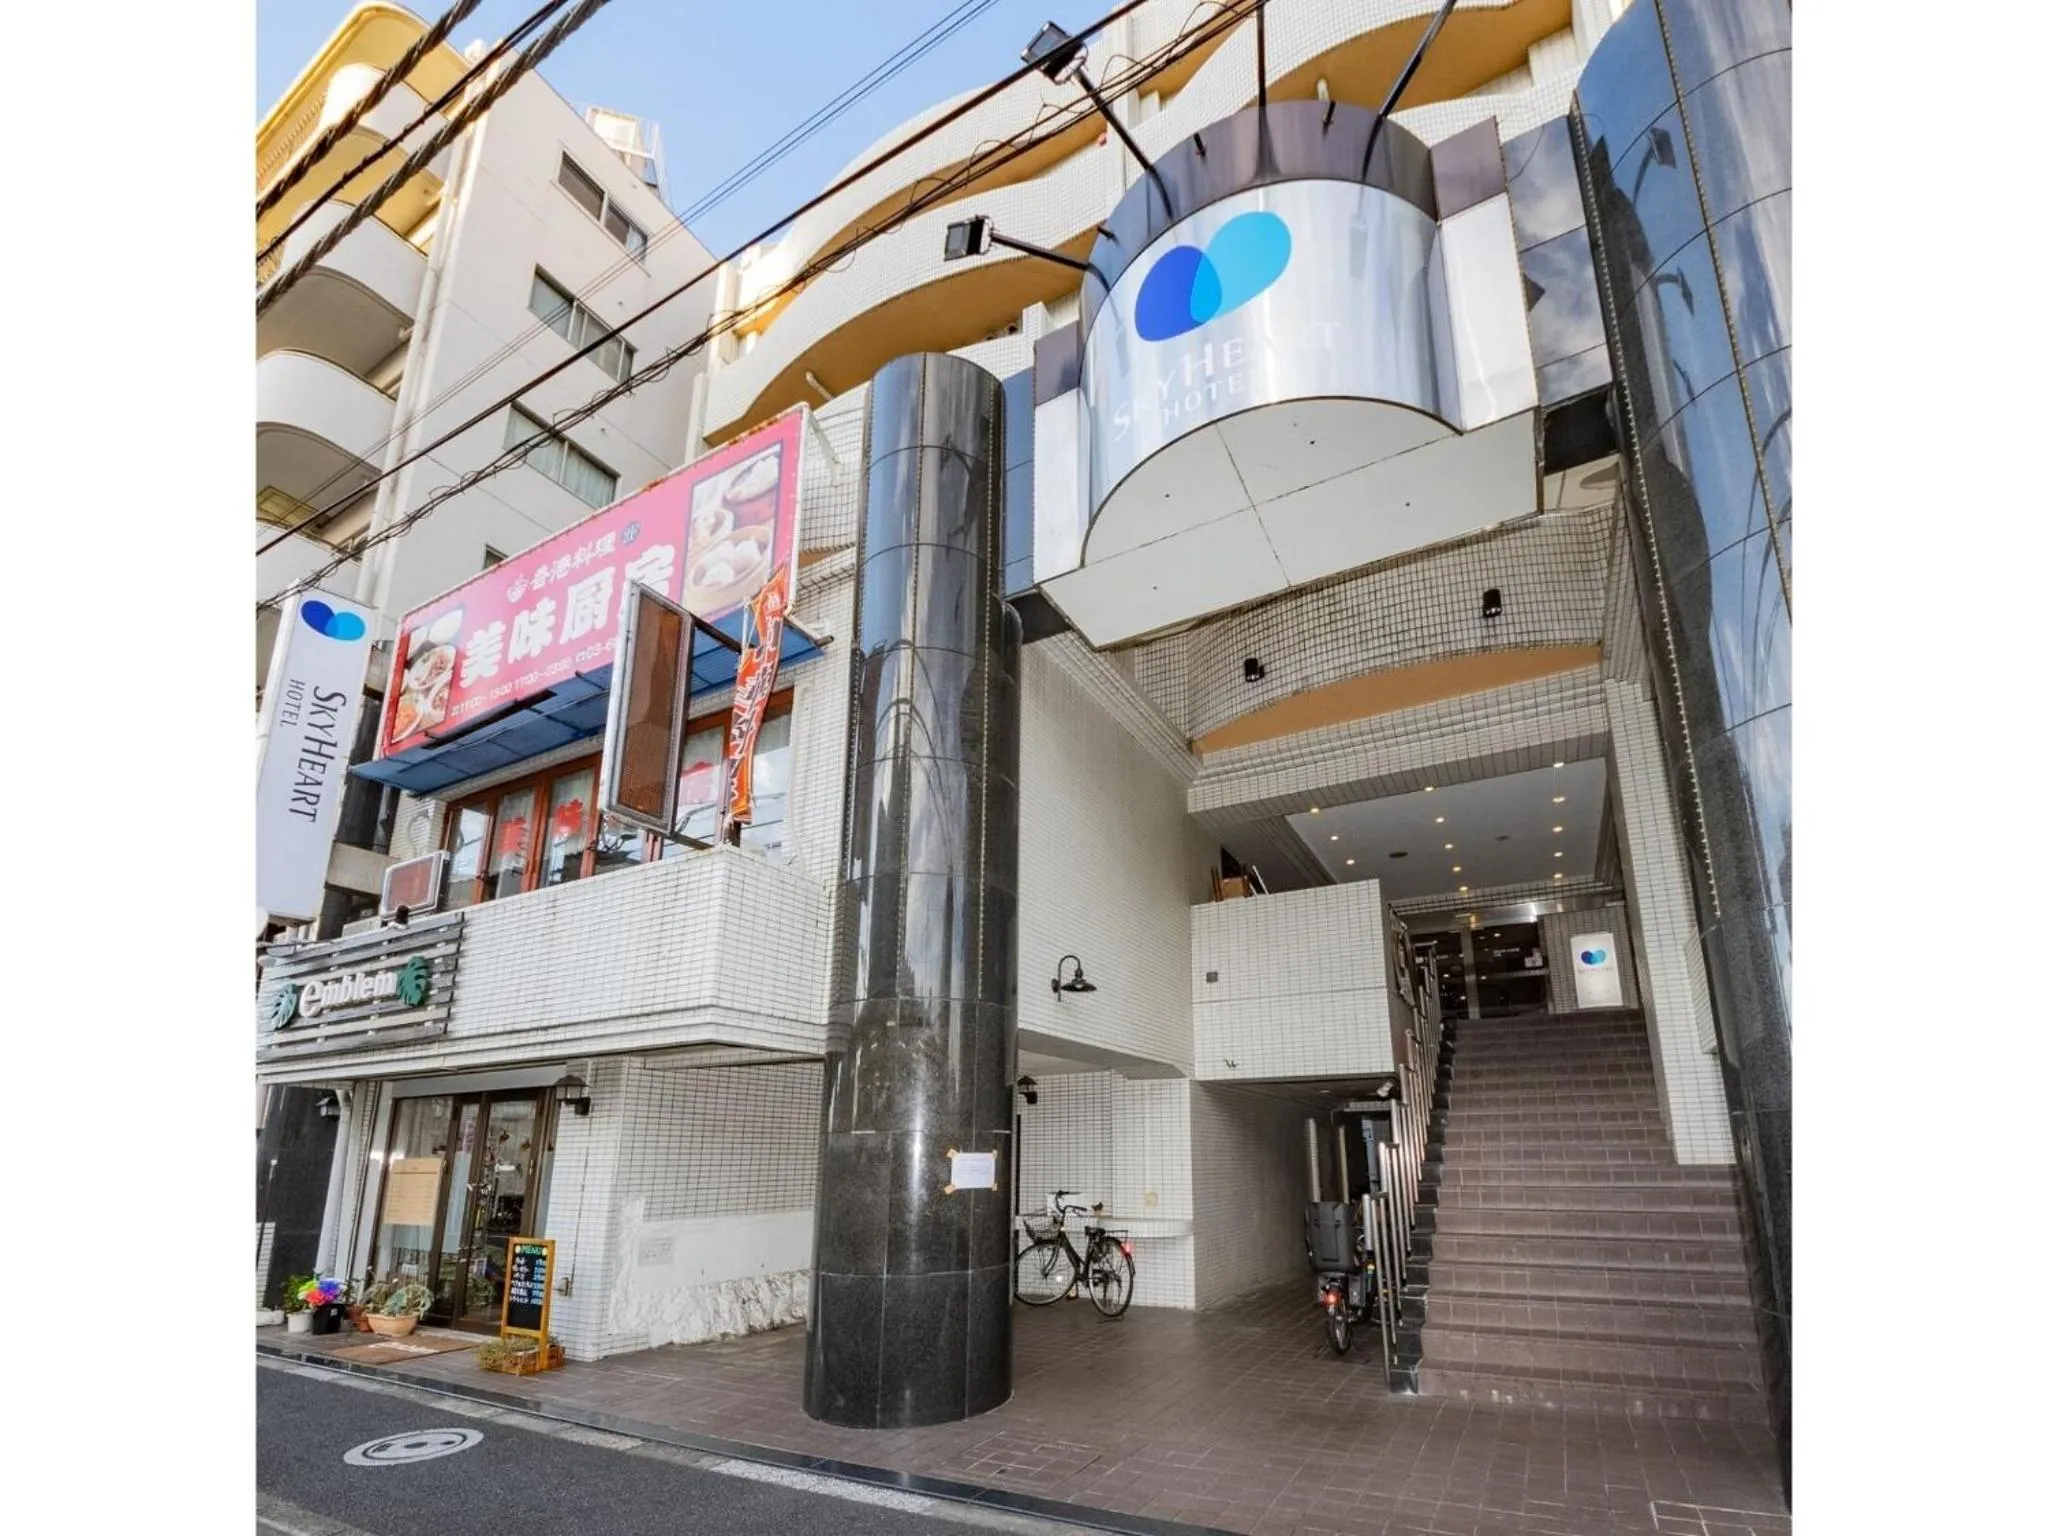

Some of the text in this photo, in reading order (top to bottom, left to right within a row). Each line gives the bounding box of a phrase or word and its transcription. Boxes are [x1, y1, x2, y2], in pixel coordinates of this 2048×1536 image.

[1113, 321, 1342, 443] SKYHET
[280, 678, 306, 728] HOTEL
[288, 685, 347, 823] SKYHEART
[300, 970, 398, 1018] emblem
